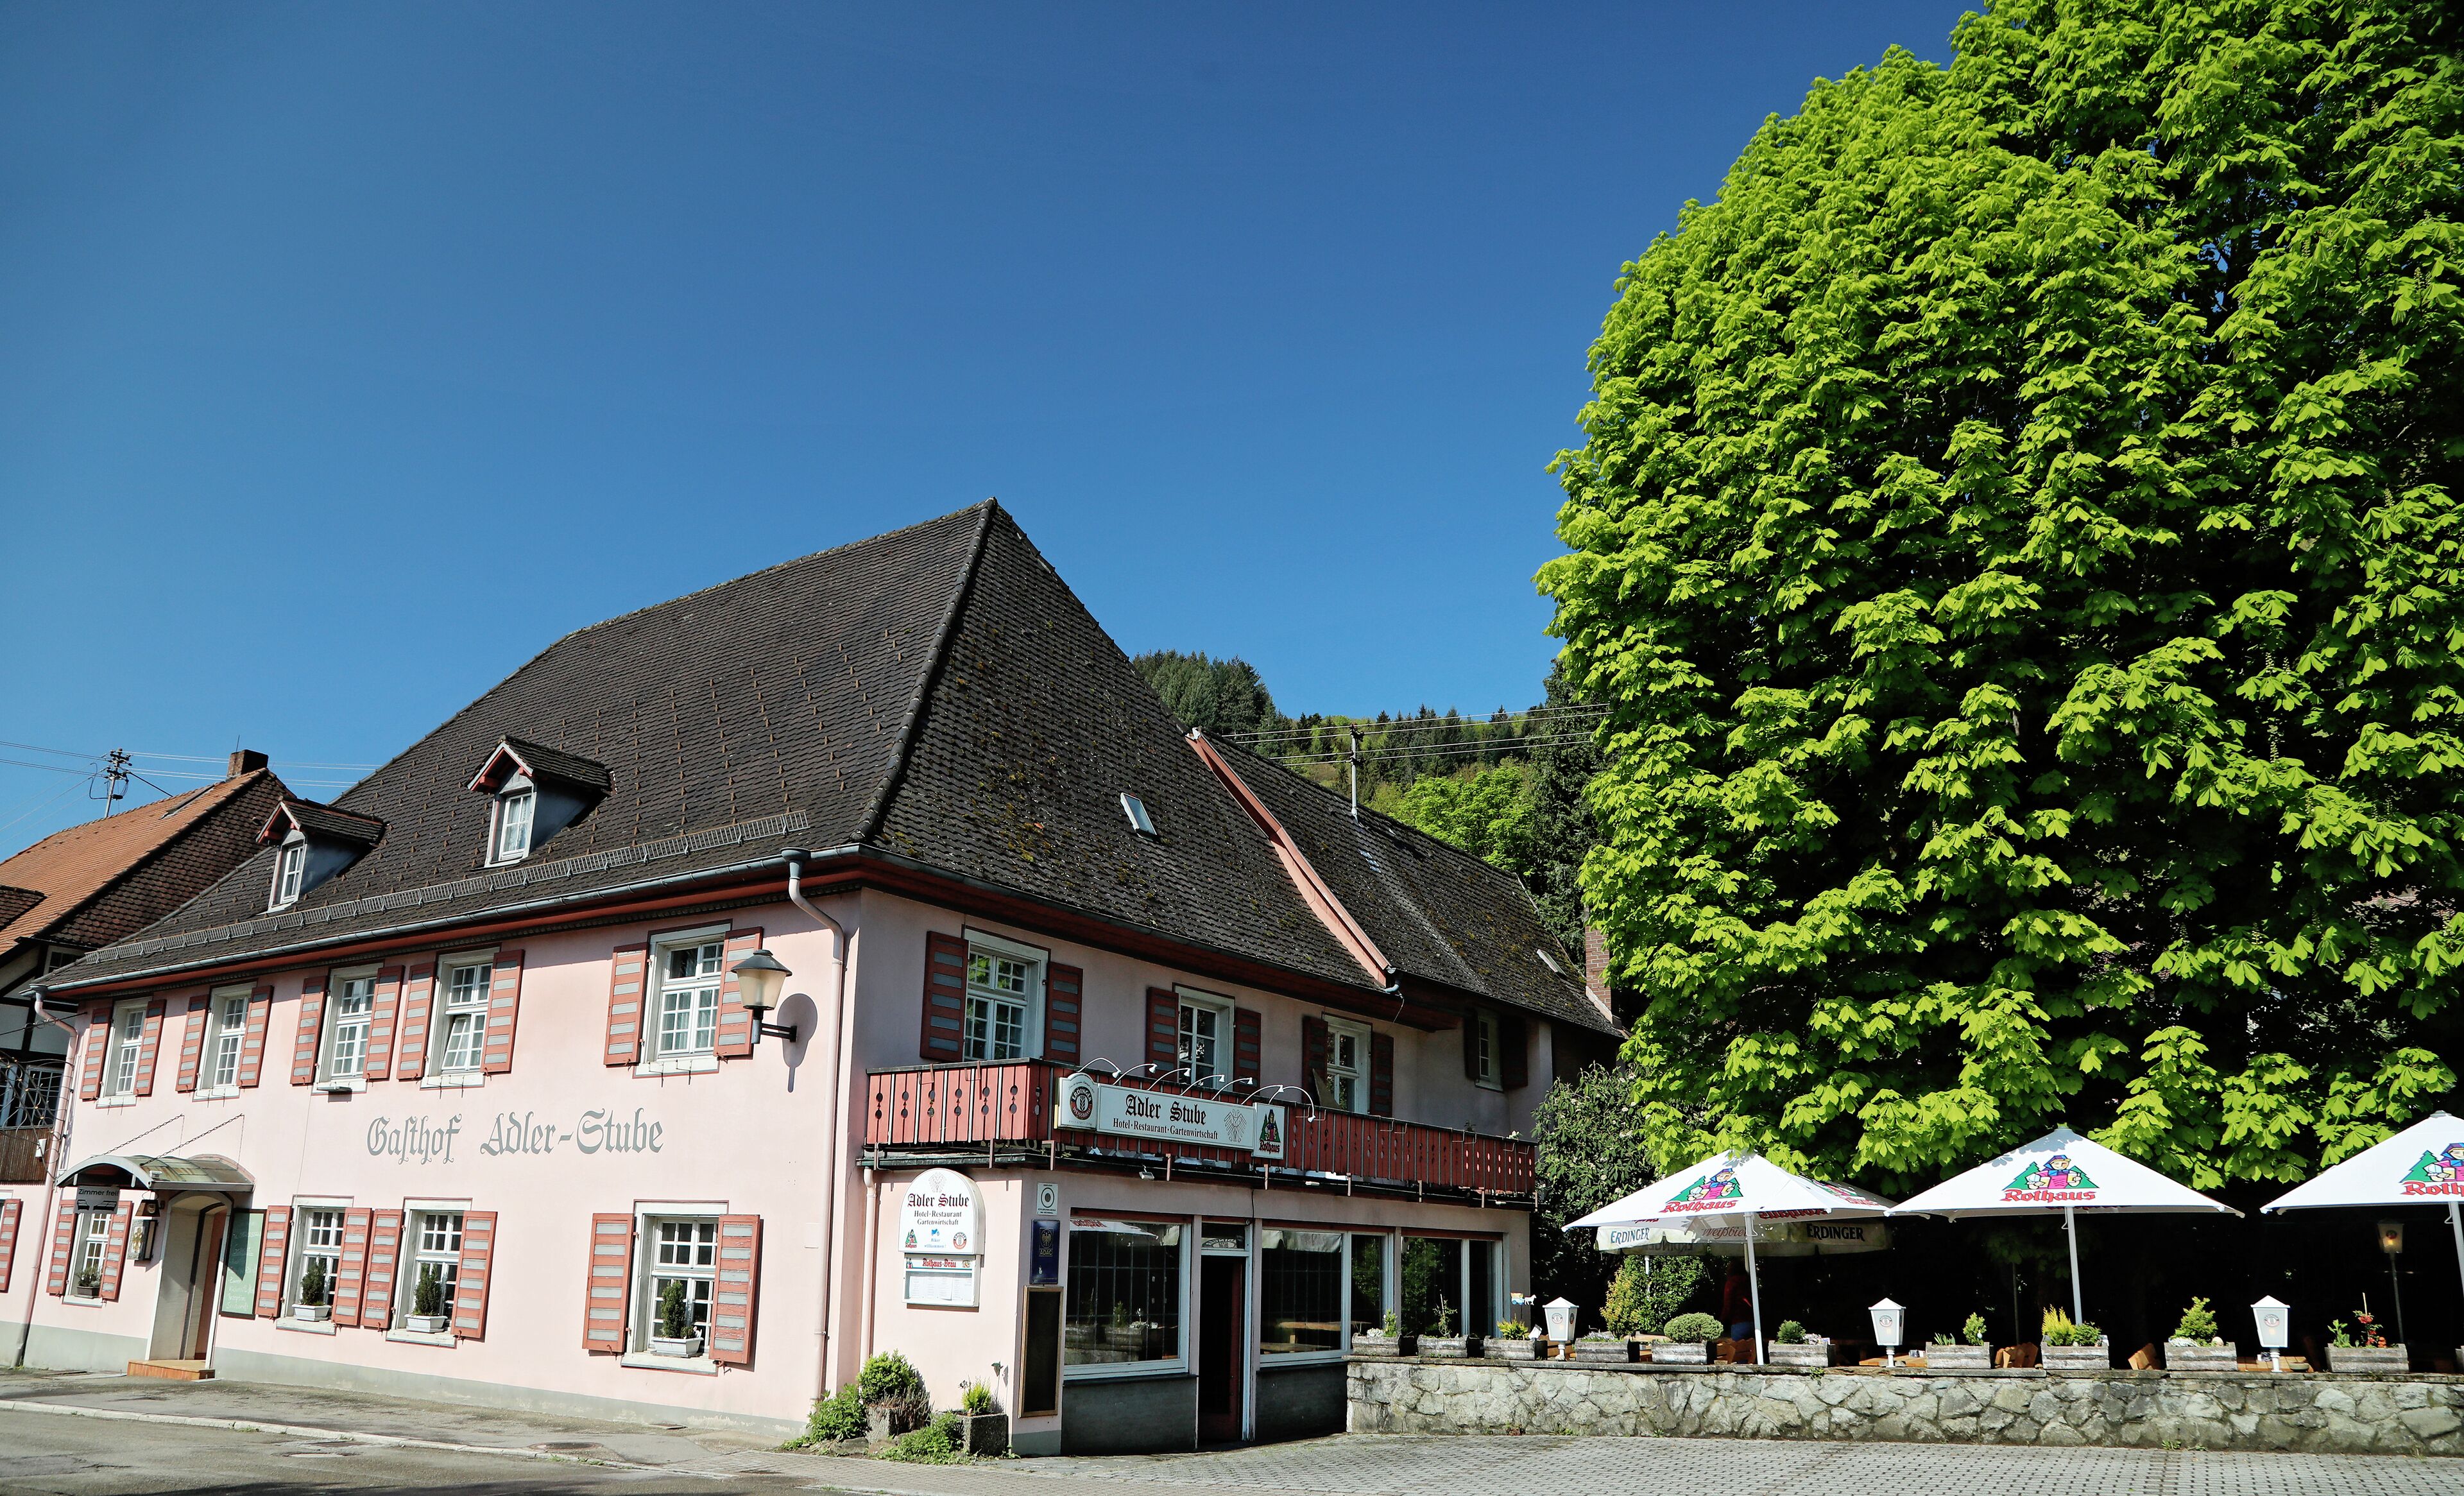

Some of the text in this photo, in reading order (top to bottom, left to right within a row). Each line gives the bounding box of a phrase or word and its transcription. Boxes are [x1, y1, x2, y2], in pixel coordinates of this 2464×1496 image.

[1125, 1094, 1207, 1125] Adler Stube
[1133, 1121, 1167, 1133] Restaurant
[1170, 1125, 1219, 1140] Gartenwirtschaft
[1999, 1189, 2098, 1203] Rothaus
[2400, 1180, 2464, 1198] Roth
[907, 1193, 970, 1207] Adler Stube
[1659, 1199, 1739, 1212] Rothaus
[1610, 1227, 1650, 1244] ERDINGER
[1807, 1223, 1865, 1242] ERDINGER
